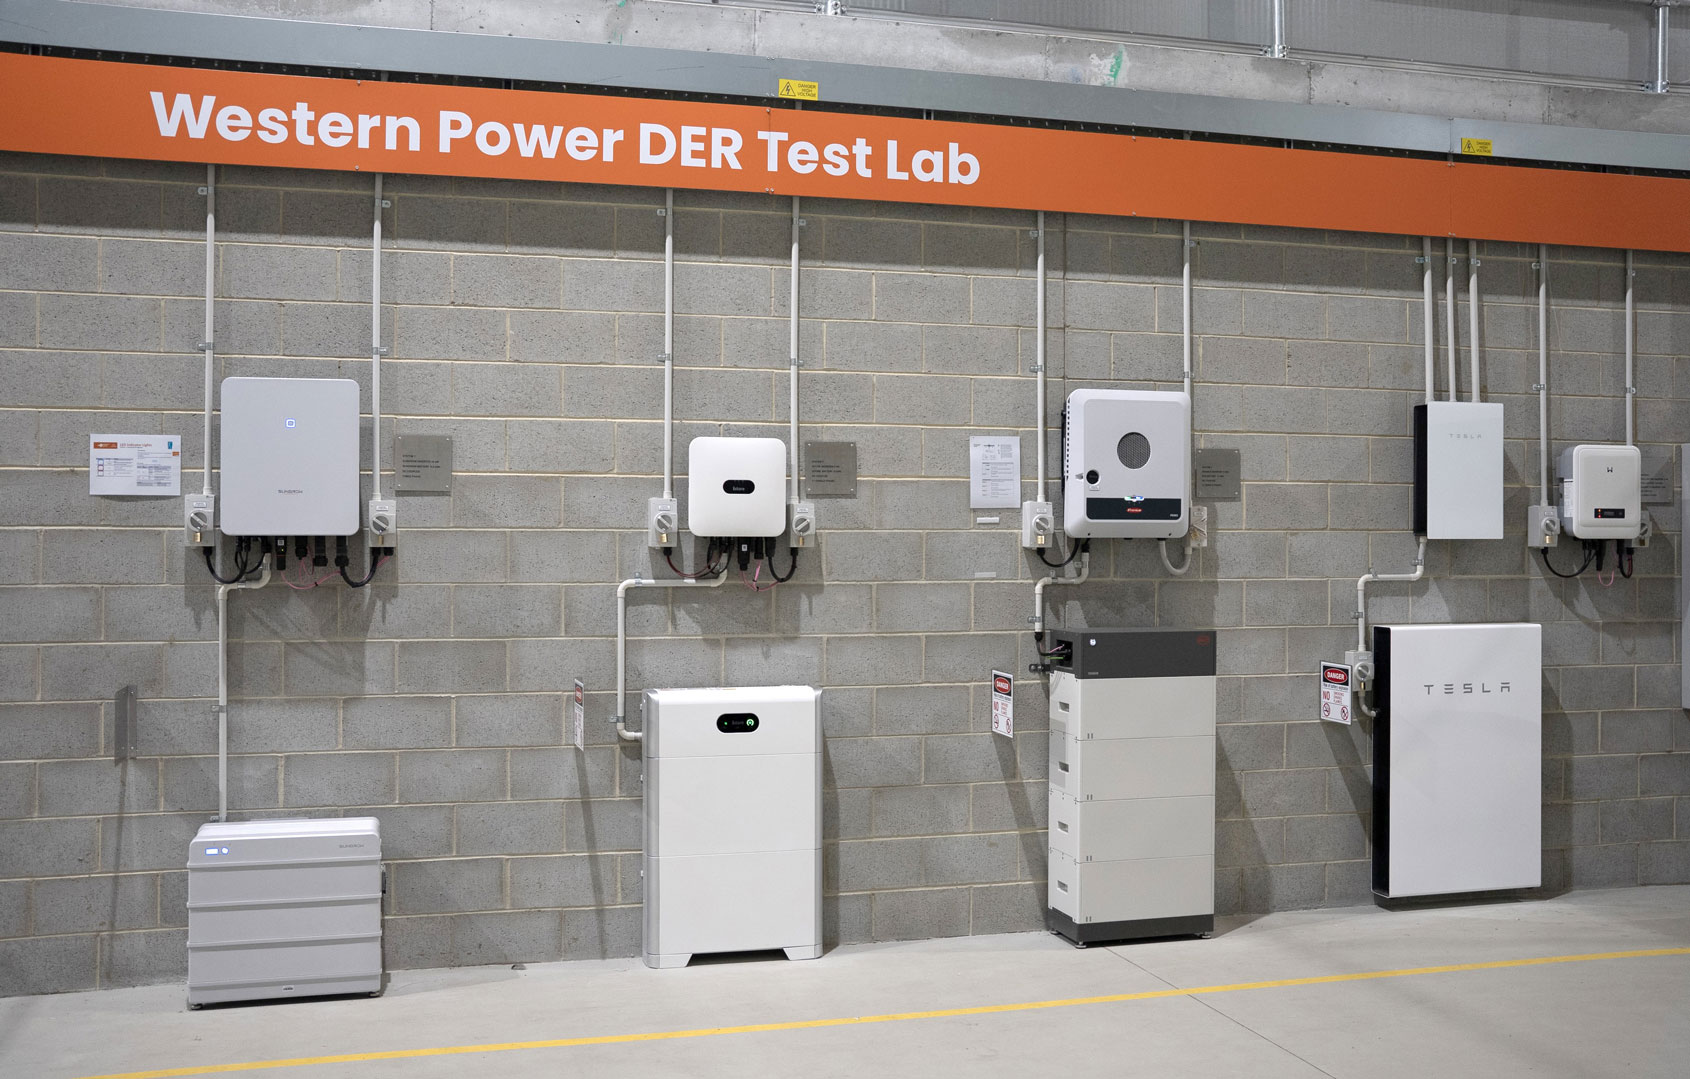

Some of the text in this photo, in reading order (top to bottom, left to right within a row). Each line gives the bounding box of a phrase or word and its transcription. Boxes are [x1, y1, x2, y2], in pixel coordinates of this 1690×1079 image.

[149, 91, 980, 185] Western Power DER Test Lab
[1326, 671, 1345, 680] DANGER
[1424, 682, 1510, 695] TESLA
[1322, 691, 1330, 700] NO
